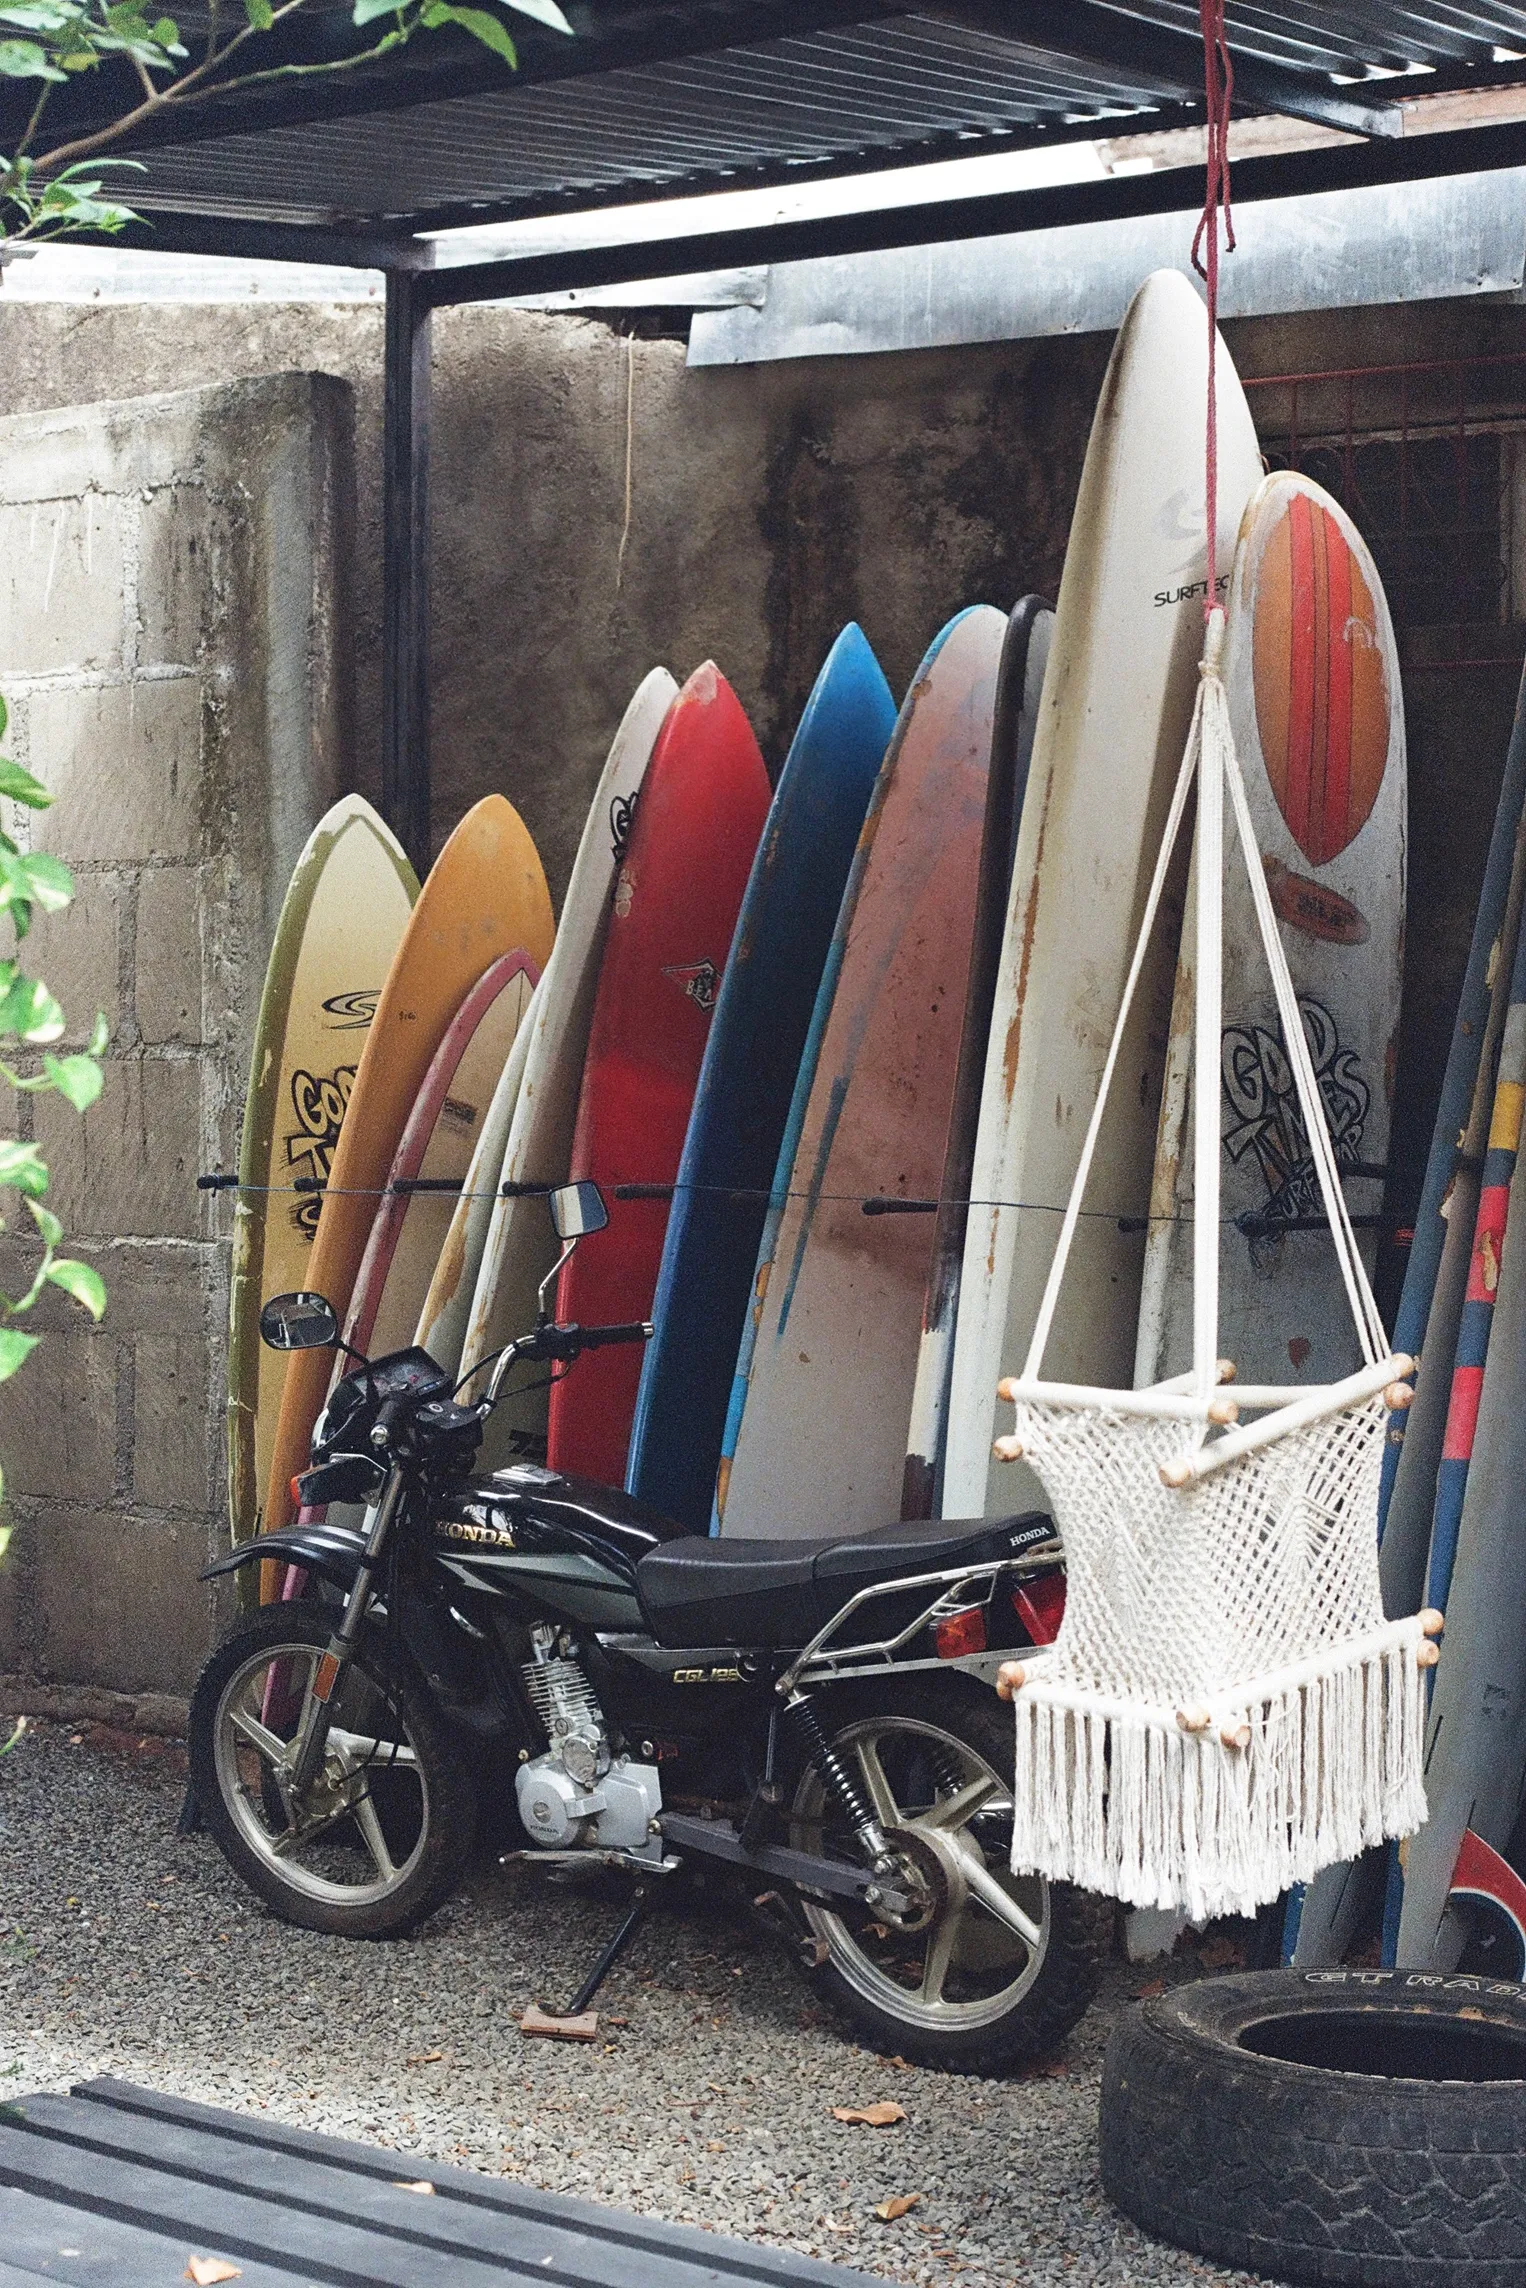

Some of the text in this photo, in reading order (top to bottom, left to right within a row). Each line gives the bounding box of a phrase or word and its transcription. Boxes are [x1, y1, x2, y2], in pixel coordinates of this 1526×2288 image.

[1154, 575, 1230, 607] SURFTEC
[685, 980, 712, 1001] BEA
[1221, 997, 1339, 1123] GOD
[1009, 1526, 1051, 1547] HONDA
[530, 1824, 560, 1835] HONDA
[1304, 1972, 1526, 2001] GT RAD
